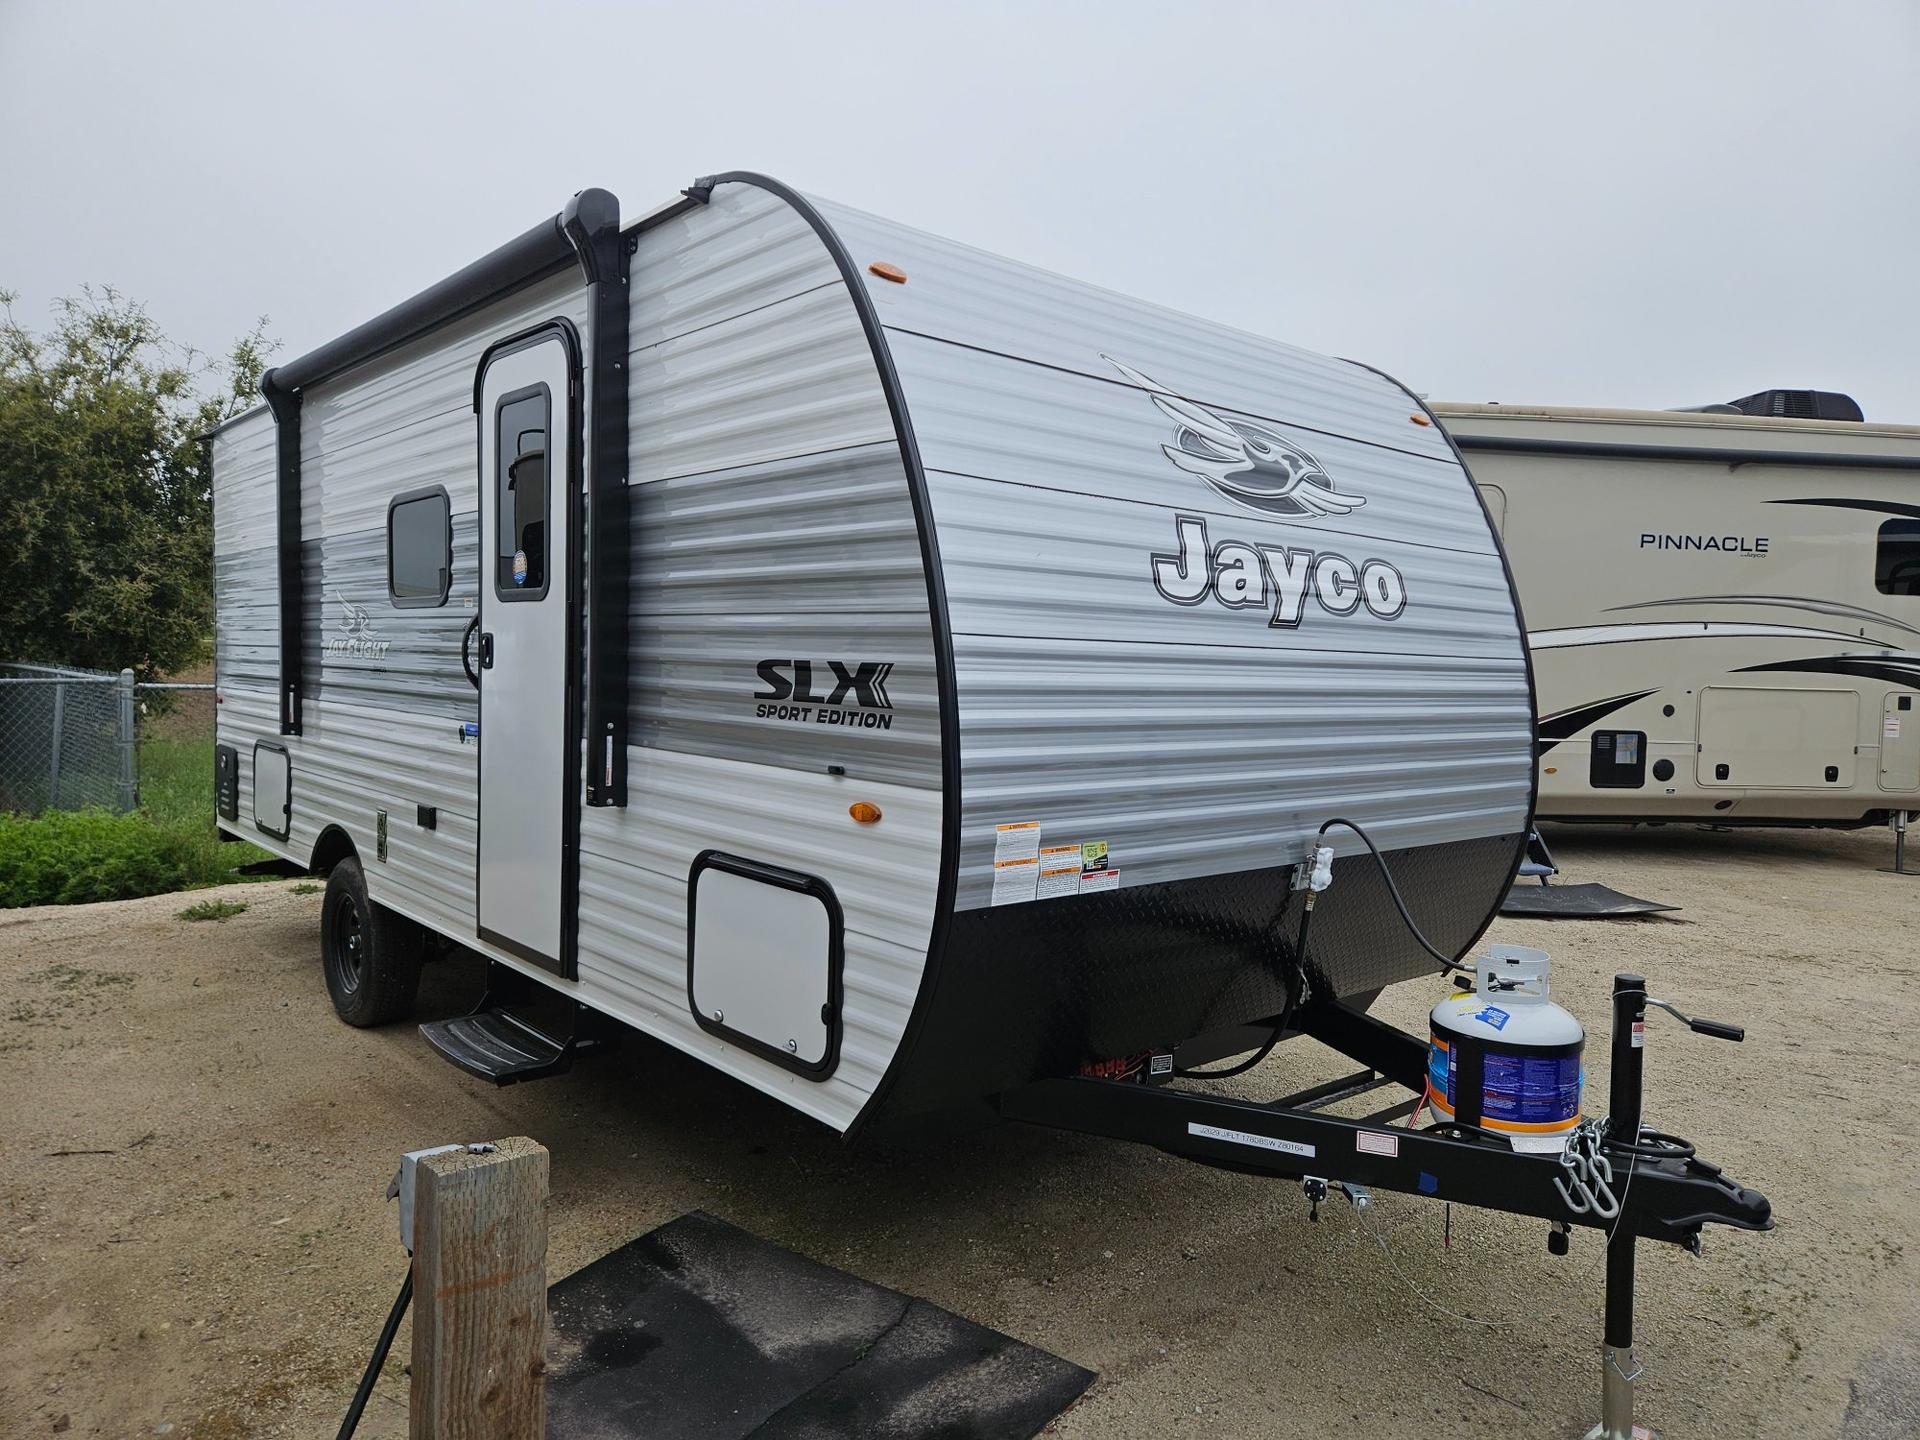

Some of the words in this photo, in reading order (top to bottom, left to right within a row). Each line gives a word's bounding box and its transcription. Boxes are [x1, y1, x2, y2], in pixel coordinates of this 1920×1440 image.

[1640, 534, 1769, 552] PINNACLE
[1150, 513, 1407, 629] Jayco
[754, 659, 895, 709] SLX
[756, 704, 812, 722] SPORT
[816, 708, 893, 730] EDITION
